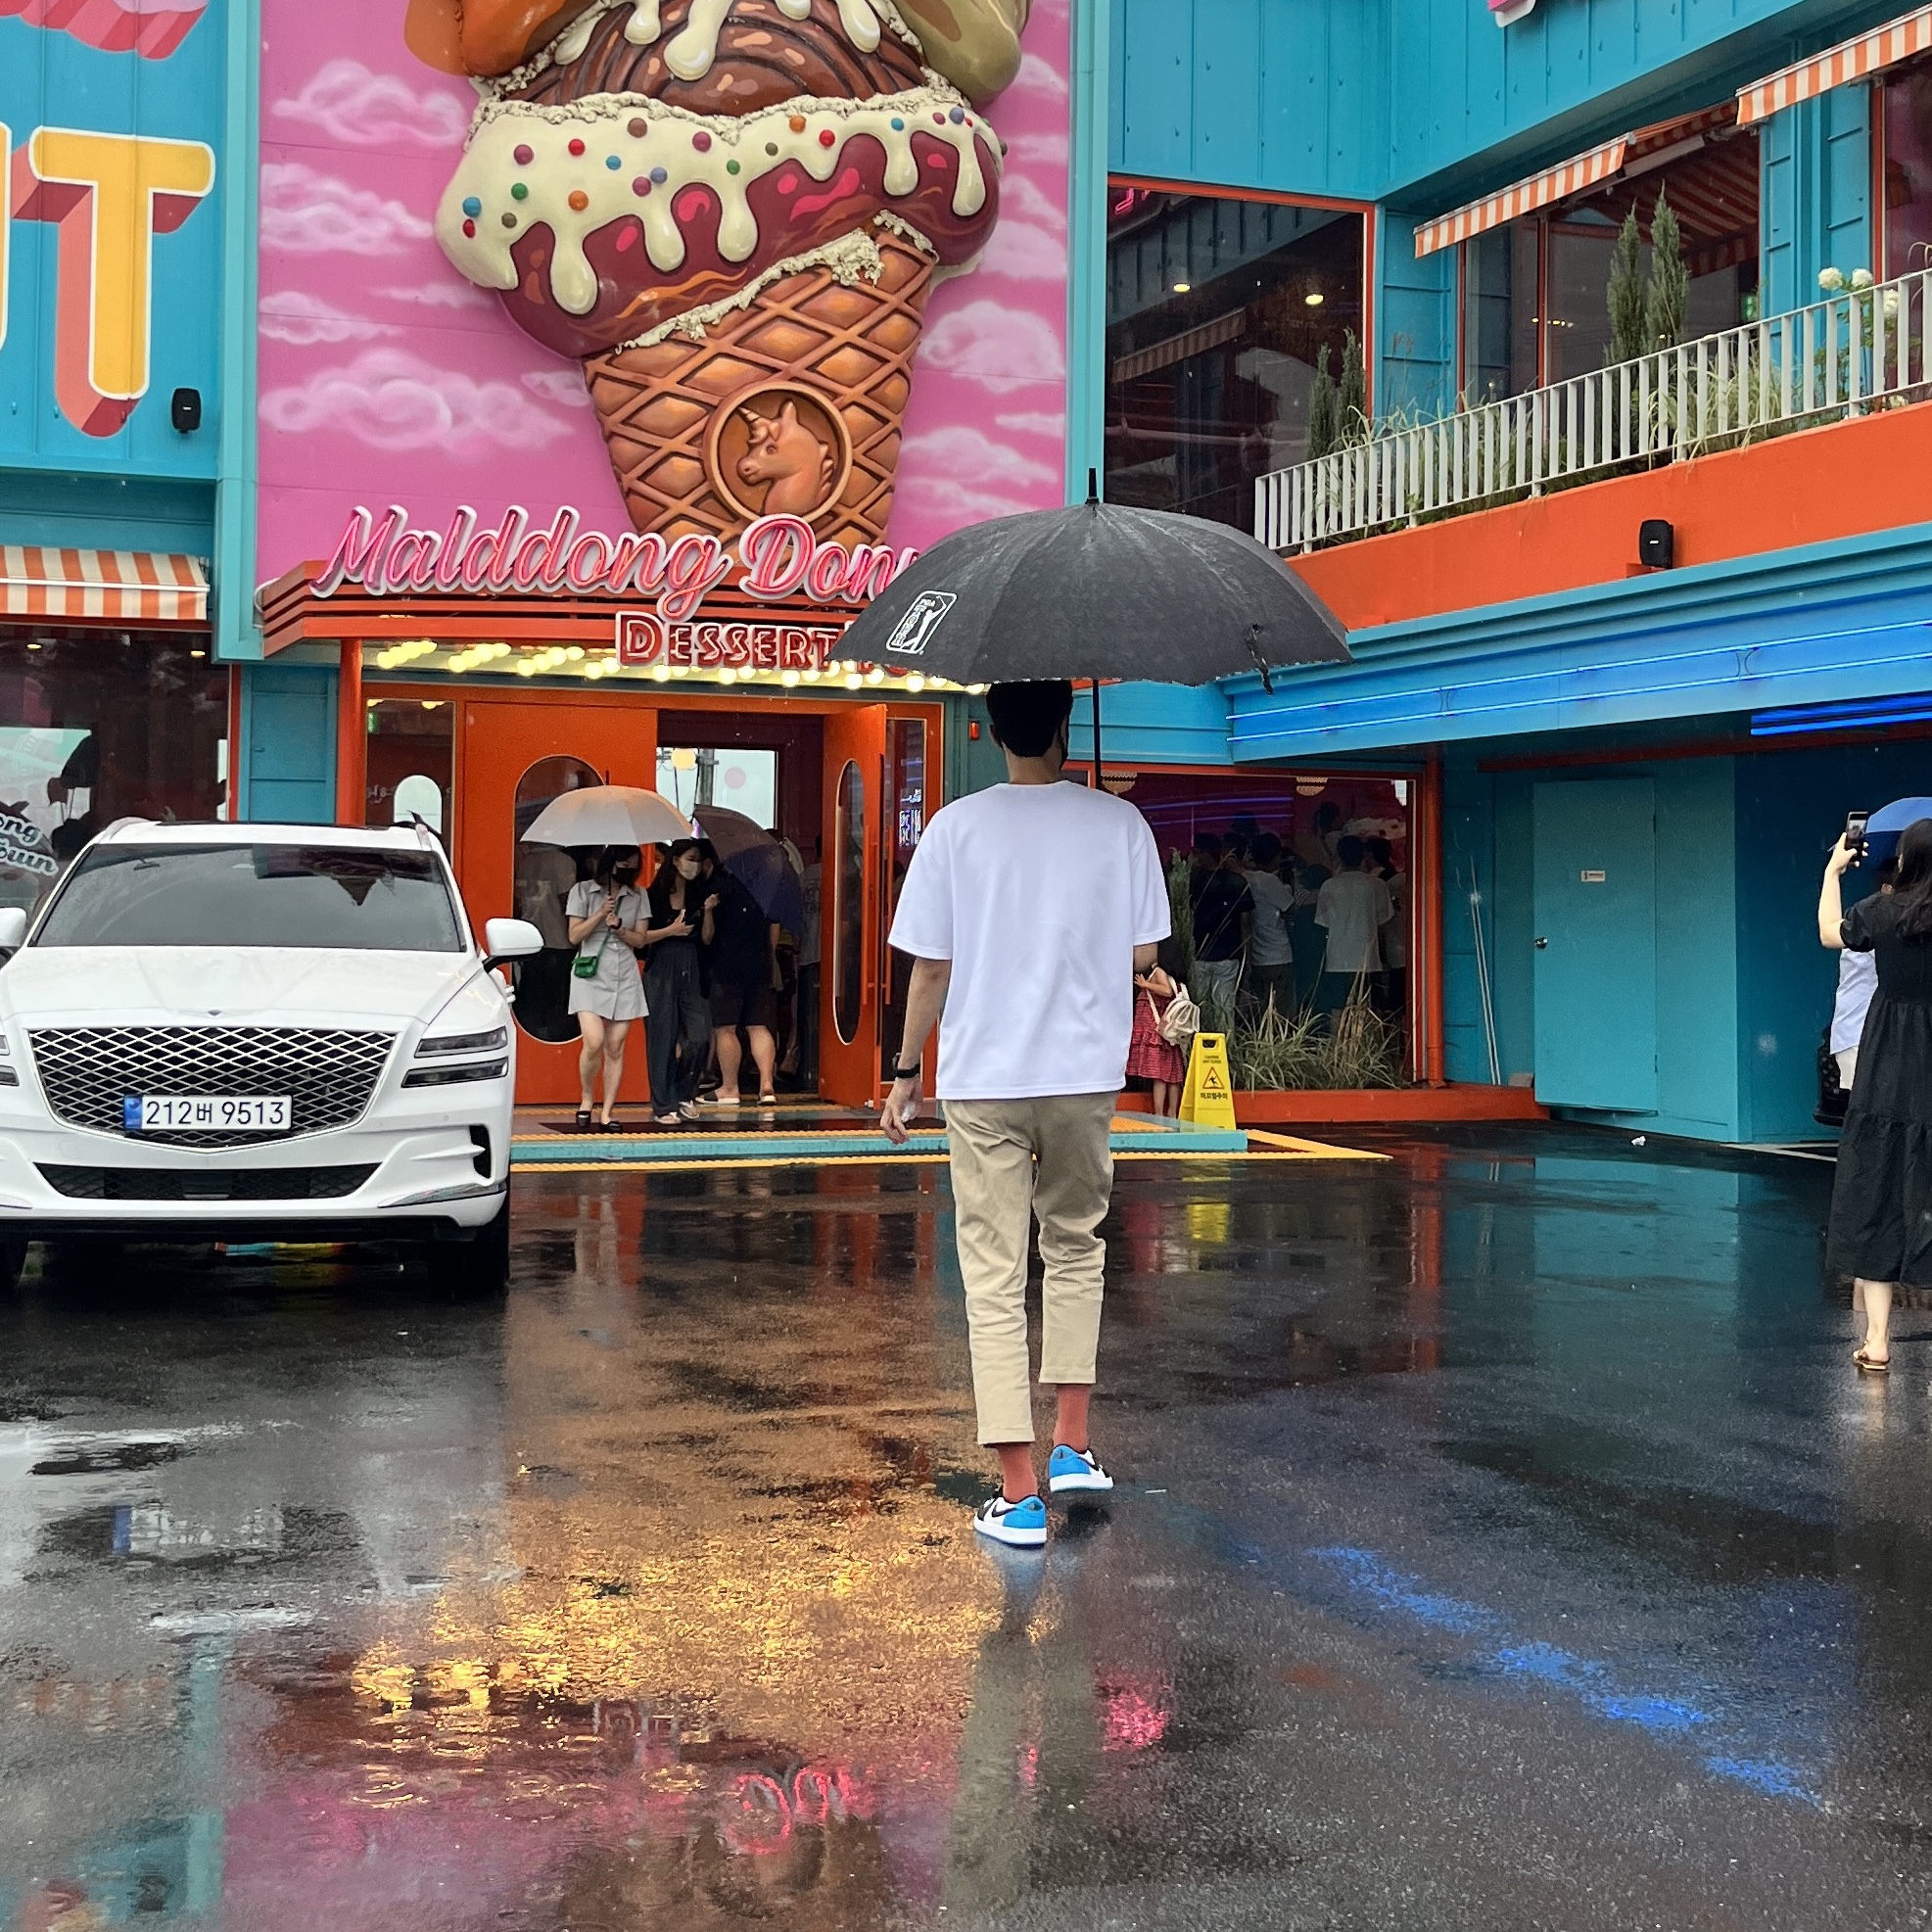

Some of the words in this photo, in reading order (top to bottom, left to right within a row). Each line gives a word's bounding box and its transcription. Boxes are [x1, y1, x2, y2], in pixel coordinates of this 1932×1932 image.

[309, 504, 732, 623] Malddong
[738, 512, 918, 603] Don
[221, 1101, 284, 1125] 9513
